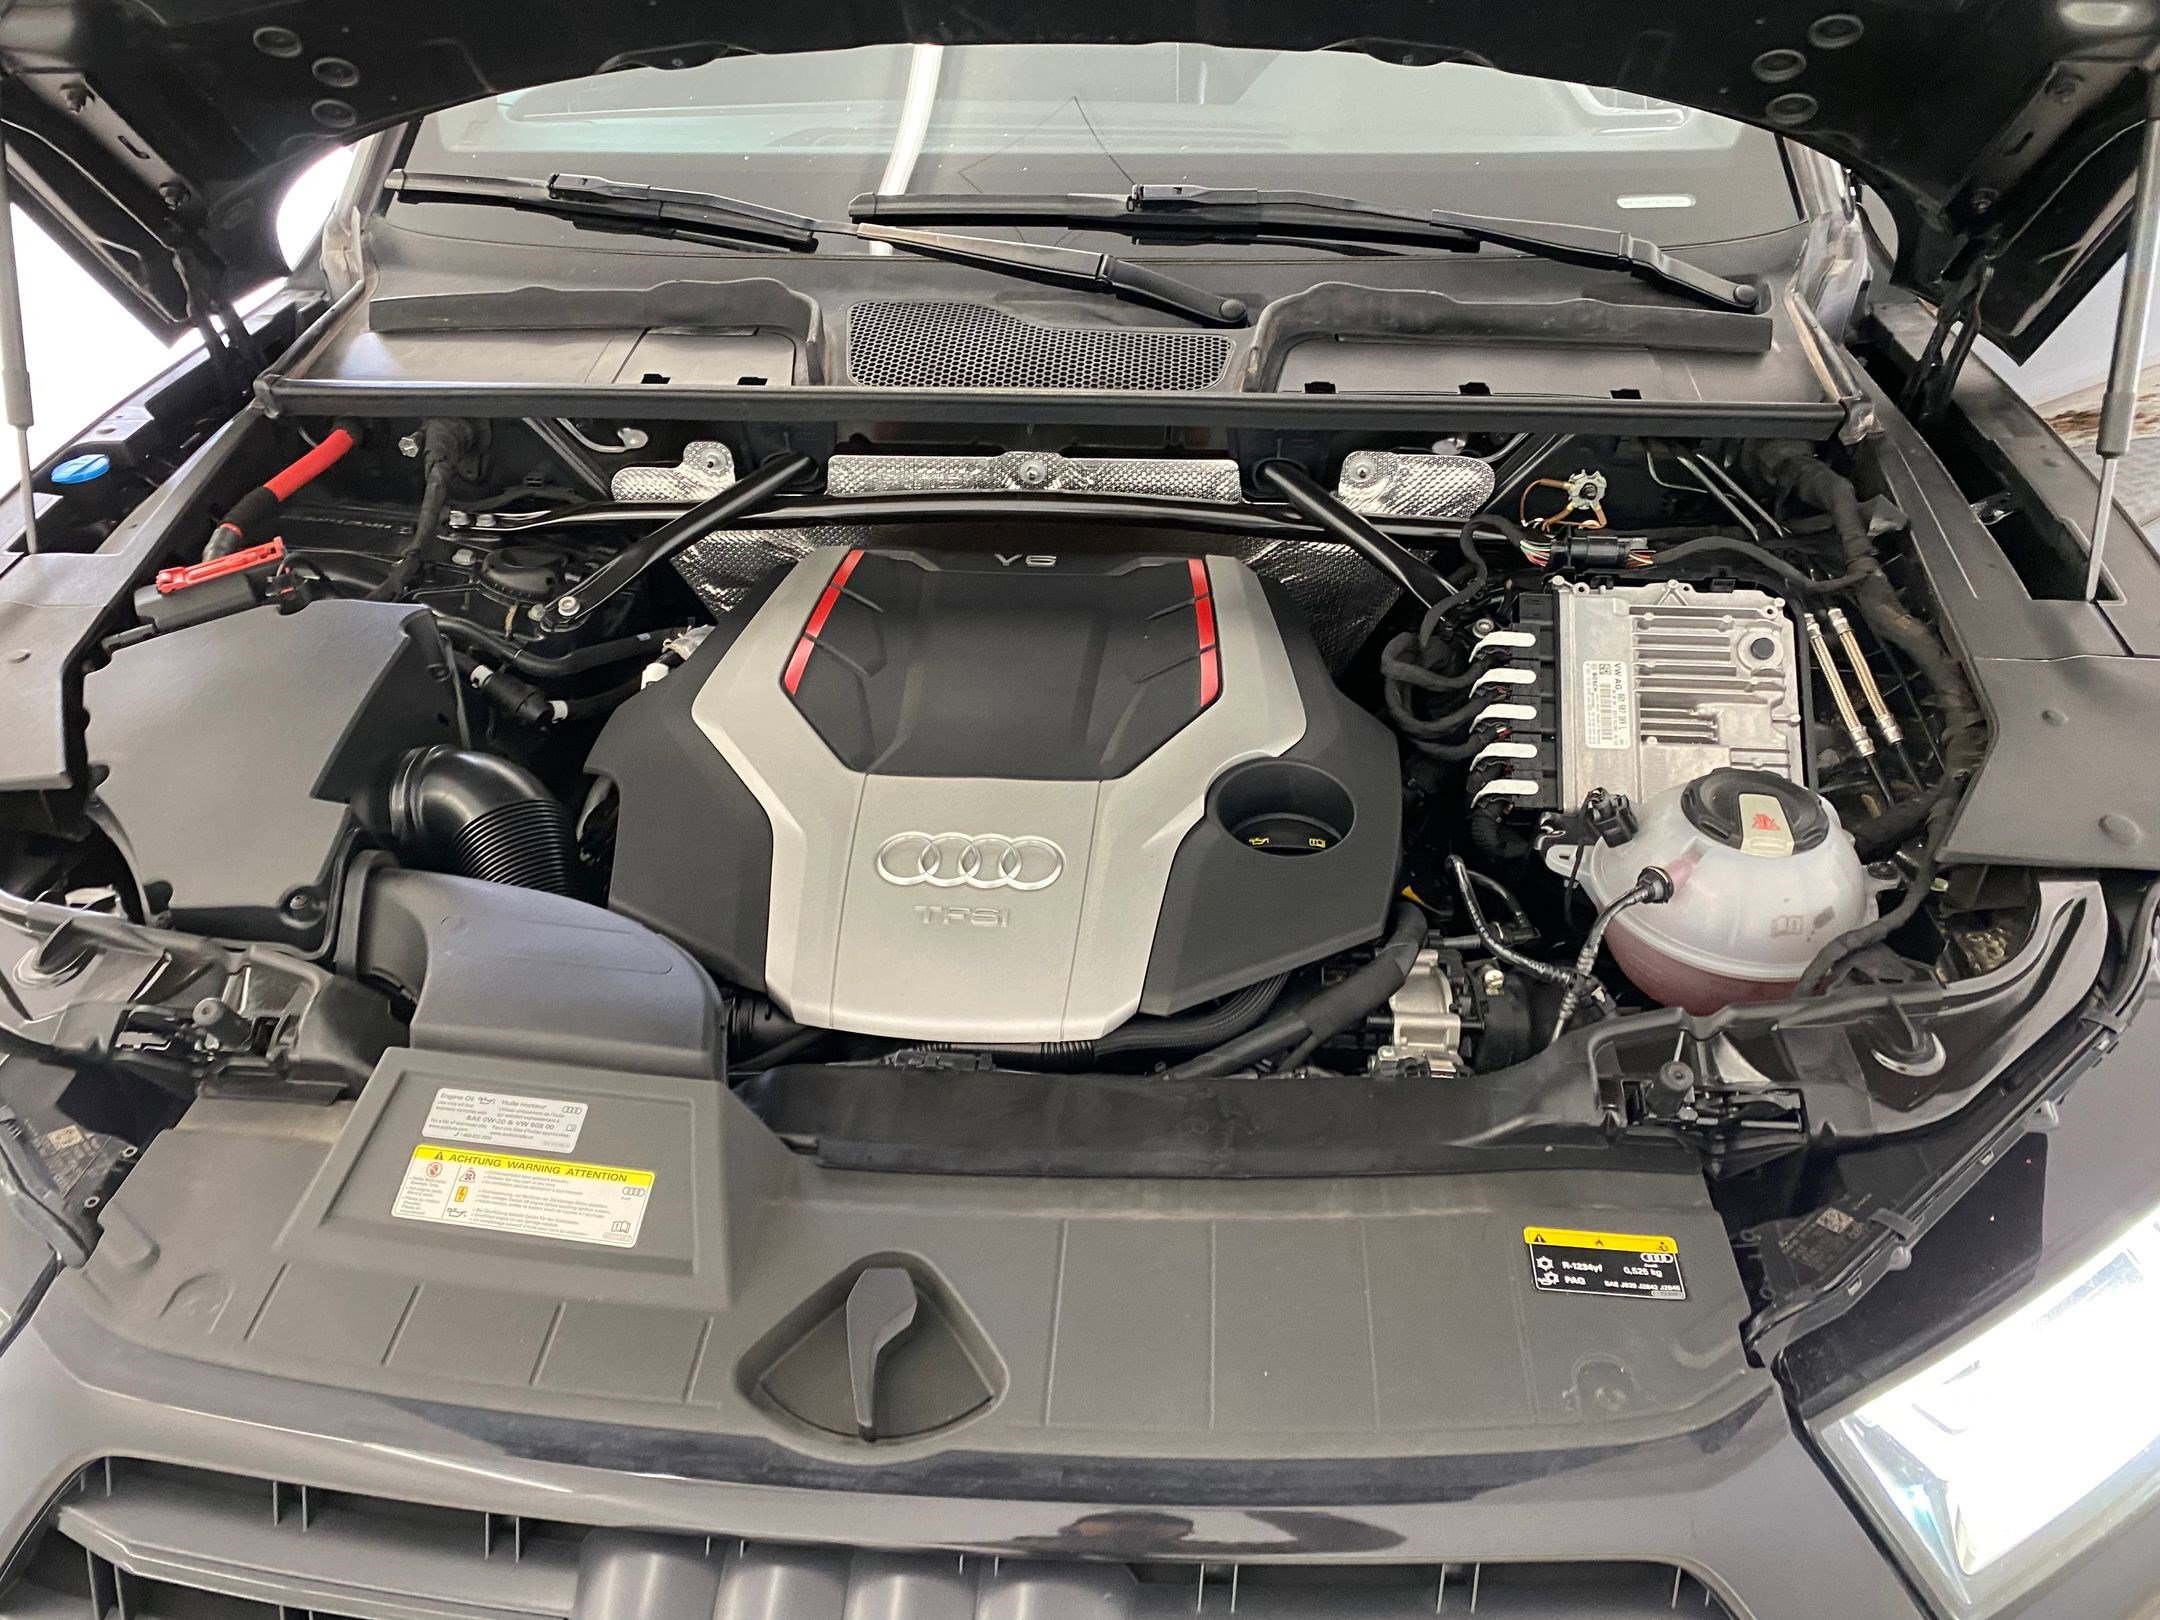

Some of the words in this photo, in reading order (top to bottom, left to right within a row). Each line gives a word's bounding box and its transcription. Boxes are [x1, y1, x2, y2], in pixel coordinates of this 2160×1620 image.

[1614, 663, 1622, 676] VW
[1615, 679, 1622, 690] AG
[913, 904, 1011, 928] TFSI
[440, 1092, 464, 1102] Engine
[501, 1099, 519, 1107] Huile
[482, 1116, 506, 1124] 0W-20
[449, 1154, 501, 1167] ACHTUNG
[507, 1160, 561, 1174] WARNING
[566, 1168, 628, 1182] ATTENTION
[1561, 1261, 1603, 1274] R-1234yf
[1623, 1266, 1650, 1276] 0,525
[1650, 1268, 1663, 1278] kg
[1564, 1276, 1586, 1285] PAG
